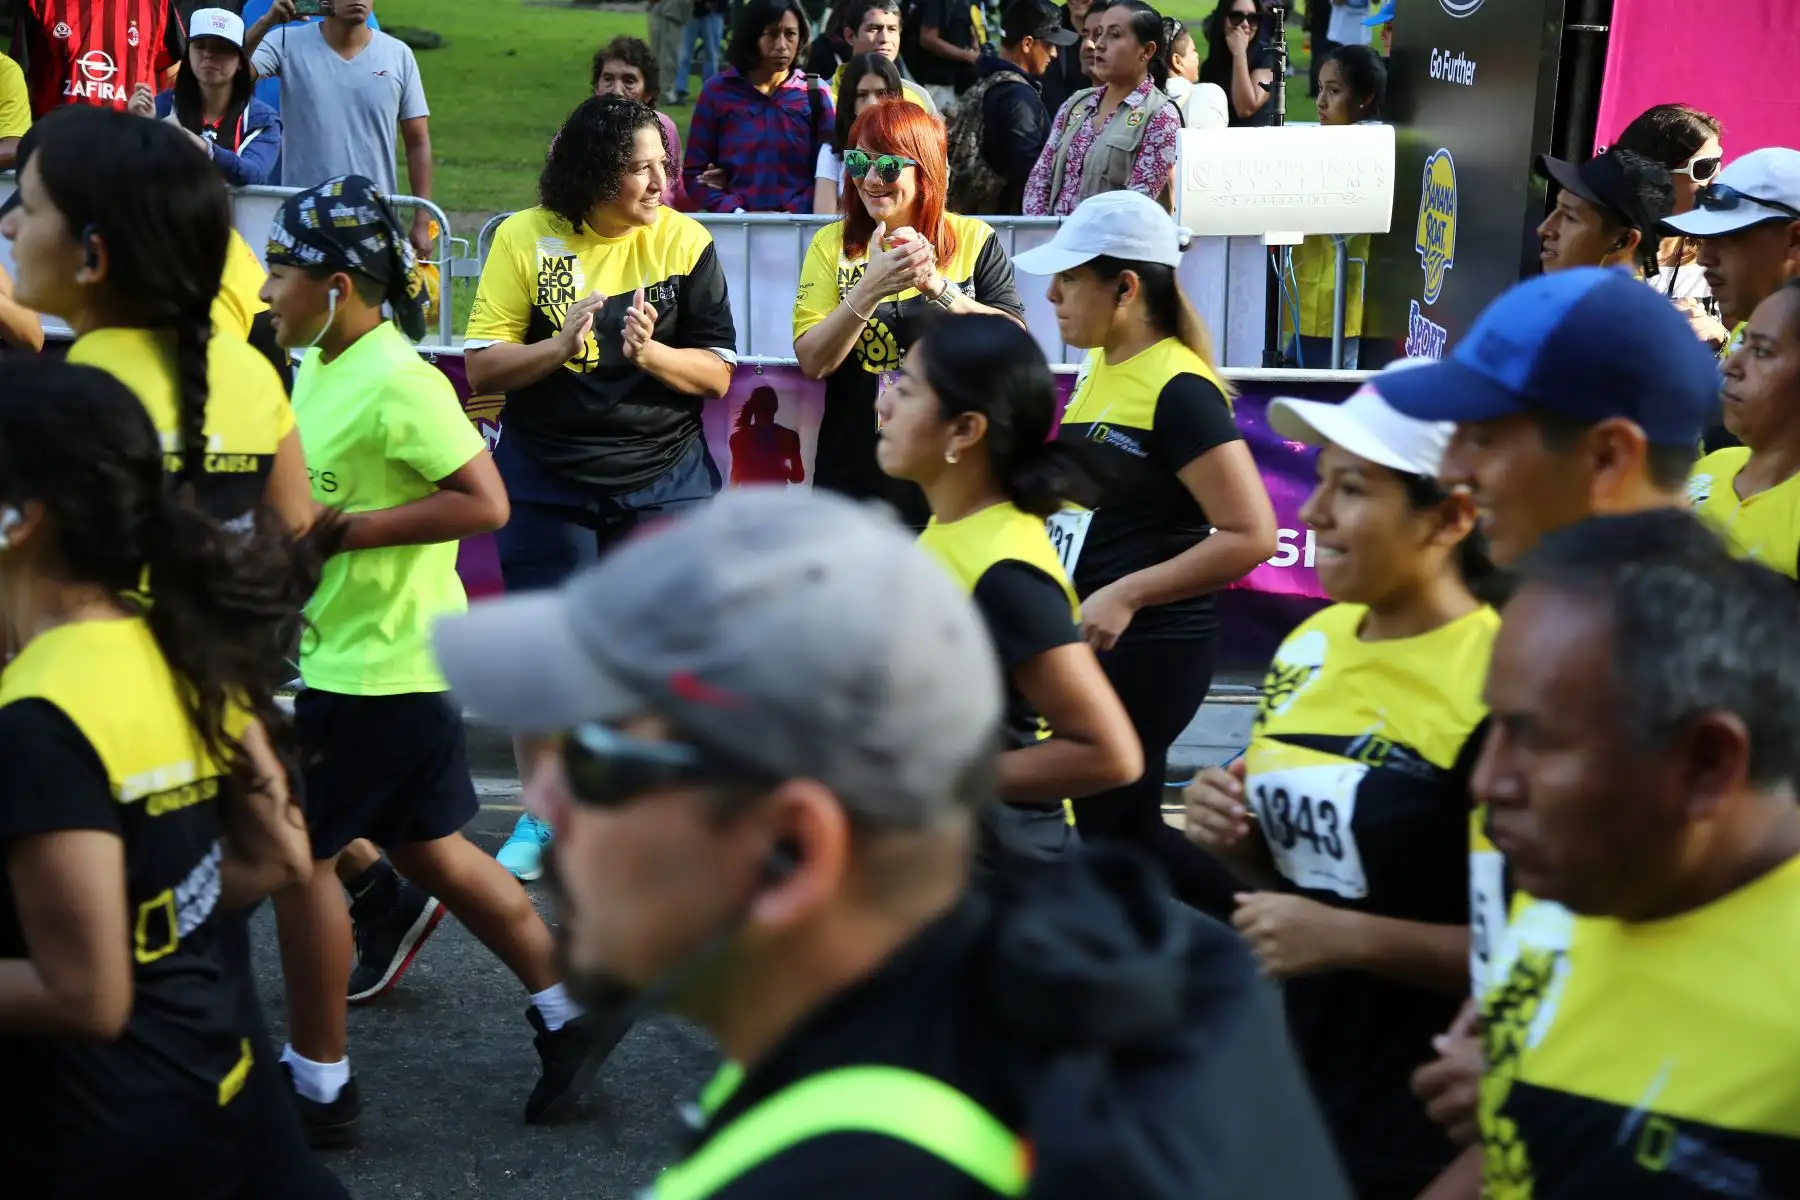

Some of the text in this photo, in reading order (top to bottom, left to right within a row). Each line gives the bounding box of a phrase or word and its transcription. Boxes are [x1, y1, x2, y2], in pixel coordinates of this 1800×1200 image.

[1430, 47, 1476, 85] Go Further
[63, 80, 128, 101] ZAFIRA
[1423, 165, 1454, 217] BANANA
[1425, 212, 1447, 249] BOAT
[543, 254, 577, 272] NAT
[537, 271, 574, 289] GEO
[537, 286, 576, 305] RUN
[1405, 300, 1447, 362] SPORT
[203, 454, 259, 473] CAUSA
[1256, 784, 1343, 862] 1343
